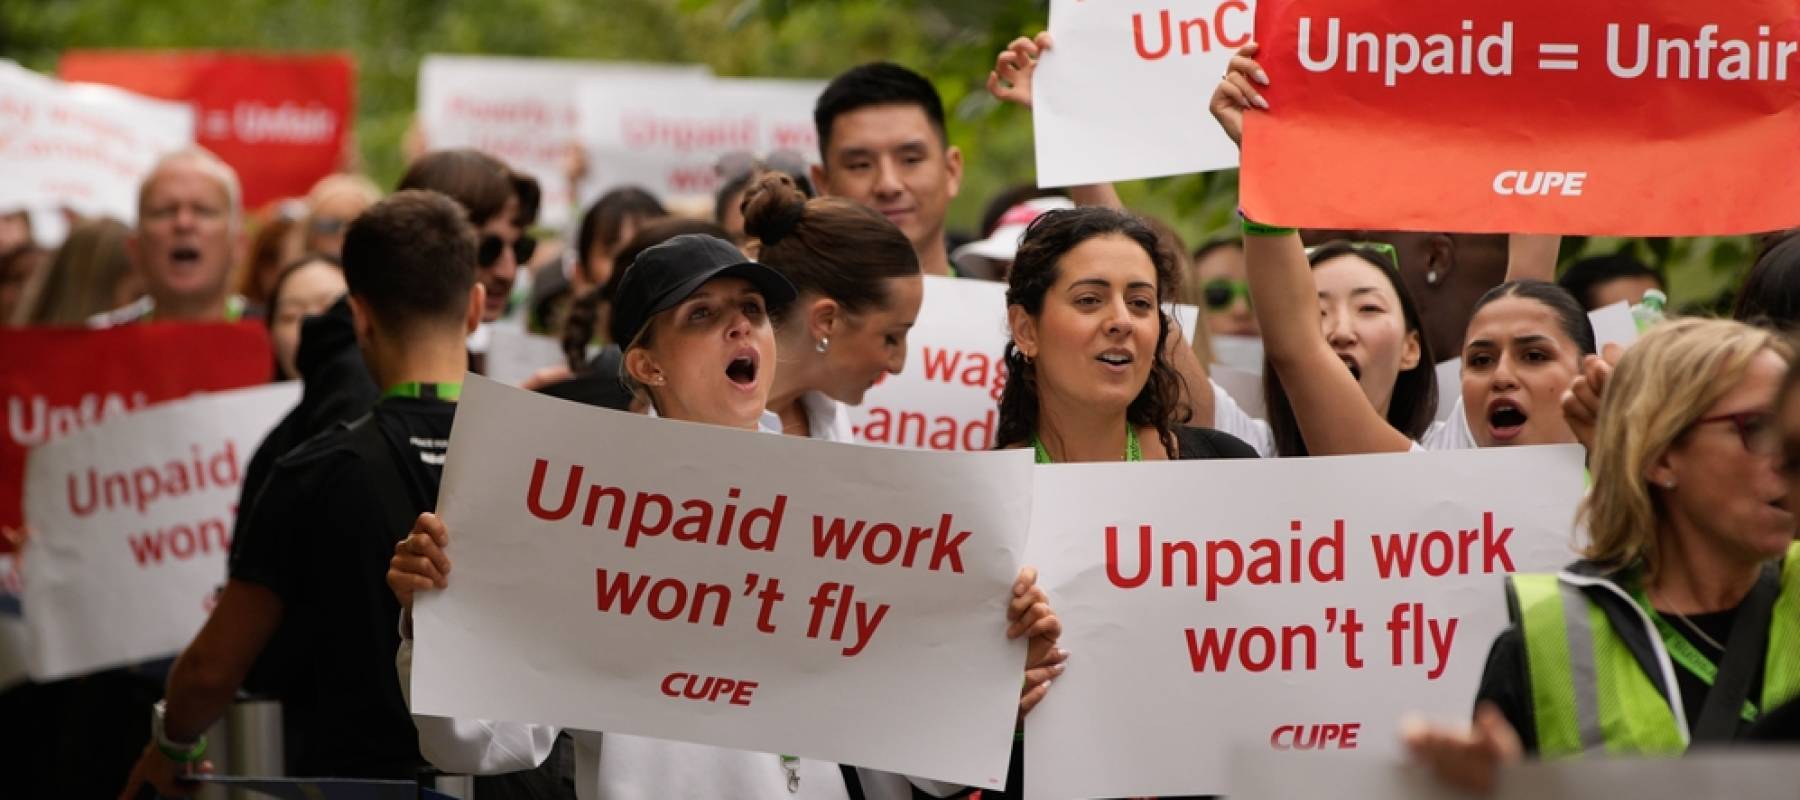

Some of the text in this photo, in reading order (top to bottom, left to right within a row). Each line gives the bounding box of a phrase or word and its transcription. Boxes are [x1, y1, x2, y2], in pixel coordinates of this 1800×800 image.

[1297, 18, 1799, 86] Unpaid = Unfair
[1492, 170, 1588, 197] CUPE
[852, 404, 996, 452] anad
[67, 440, 239, 517] Unpaid
[526, 458, 972, 574] Unpaid work
[1104, 511, 1516, 602] Unpaid work
[595, 567, 890, 657] won't fly
[1184, 601, 1460, 680] won't fly
[660, 671, 760, 706] CUPE
[1269, 721, 1362, 752] CUPE
